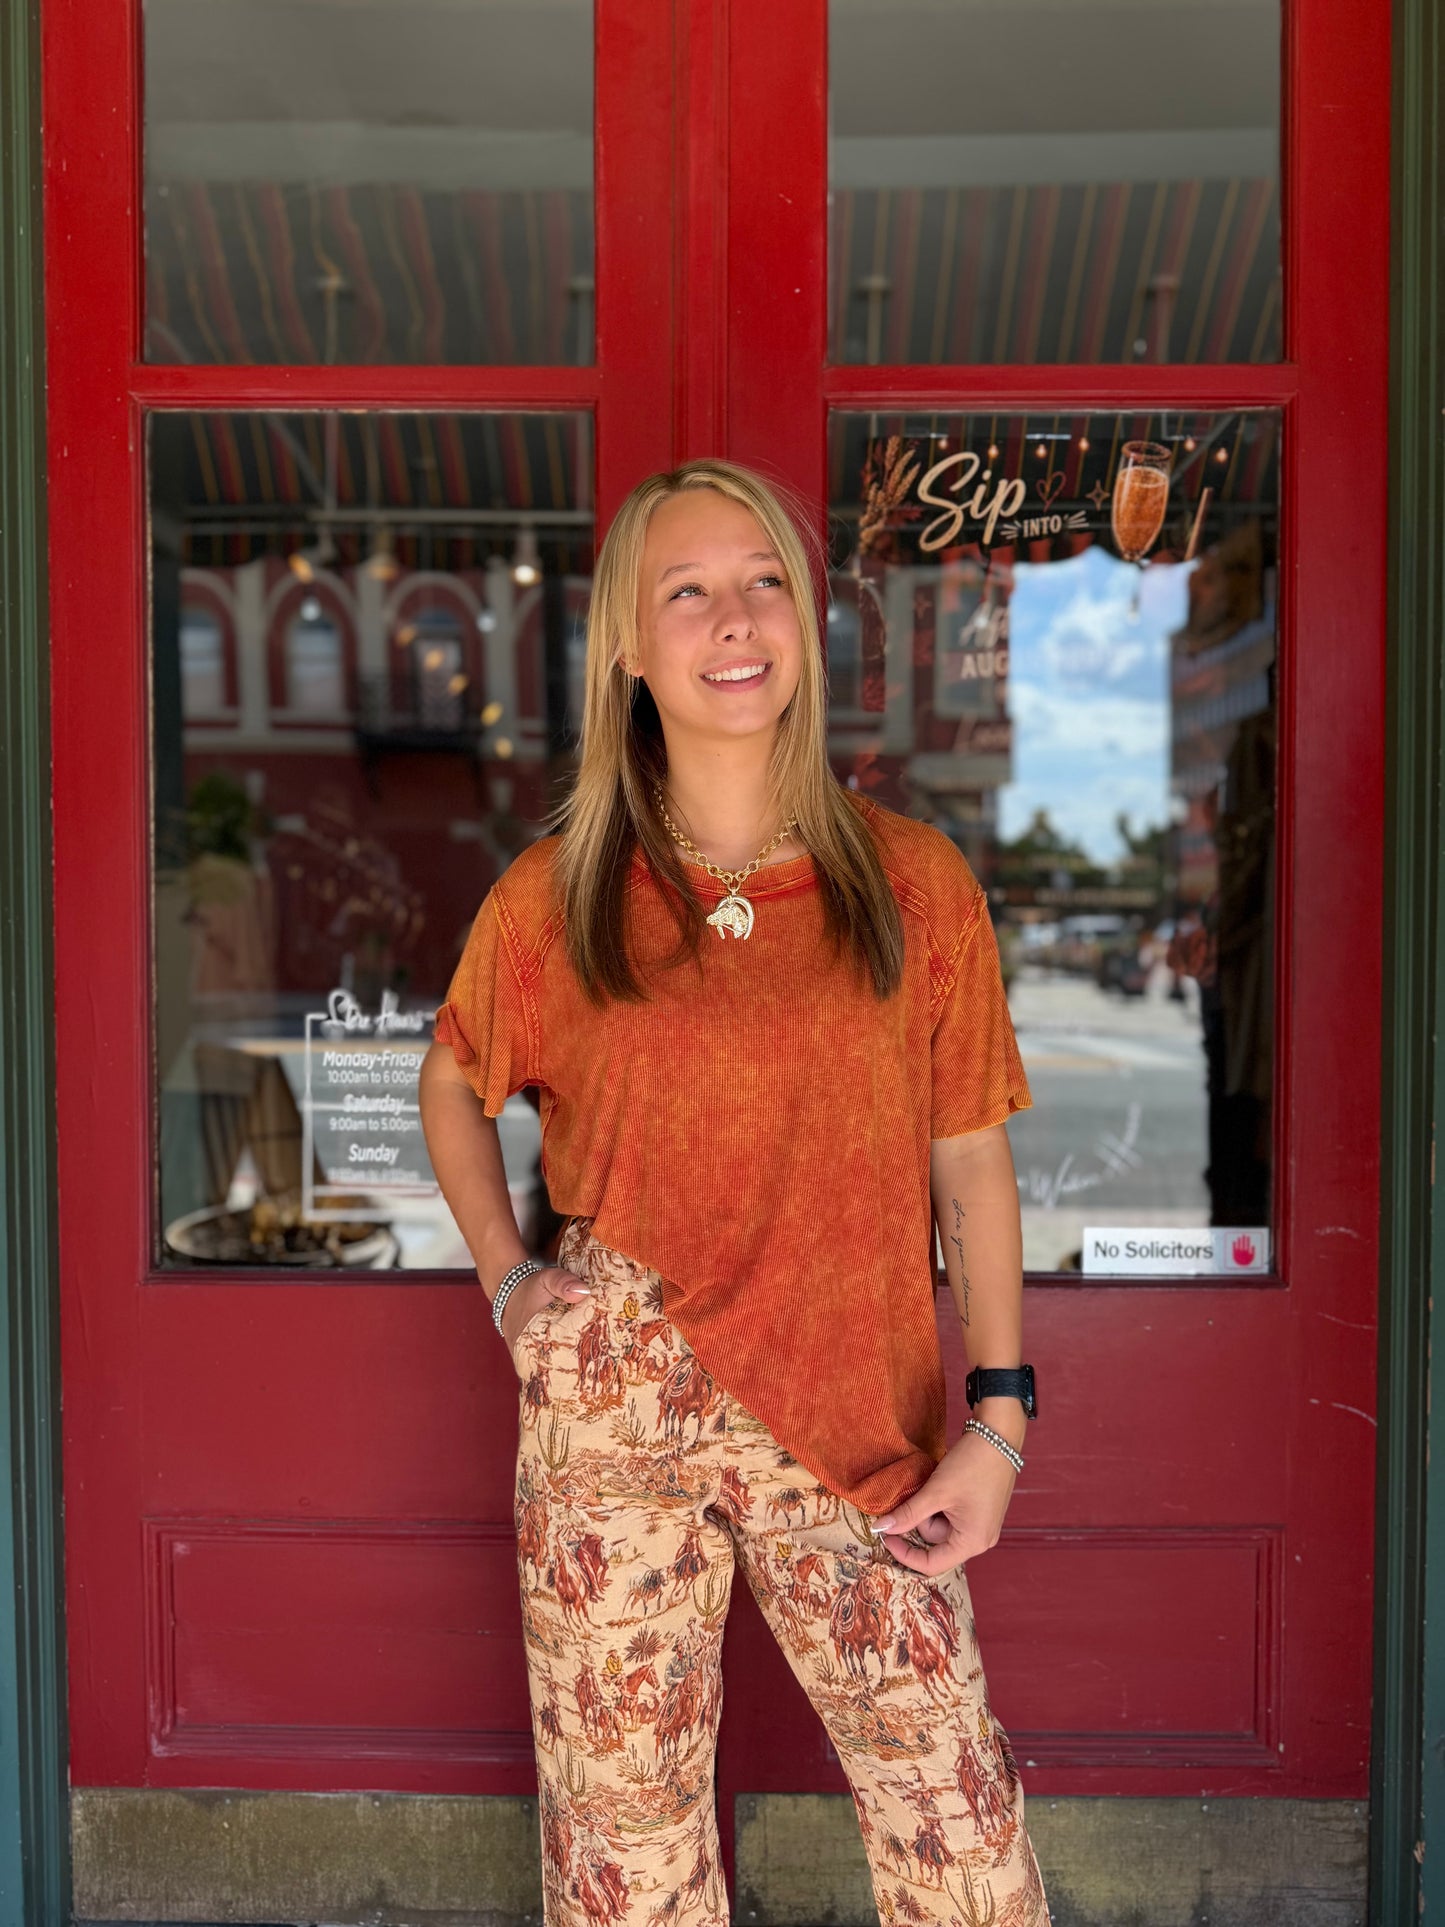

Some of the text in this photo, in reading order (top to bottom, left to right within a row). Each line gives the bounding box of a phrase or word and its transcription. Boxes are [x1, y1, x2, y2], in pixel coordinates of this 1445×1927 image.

[917, 451, 1026, 552] Sip
[1022, 513, 1062, 538] INTO
[322, 1050, 425, 1070] Monday-Friday
[370, 1070, 382, 1083] to
[343, 1093, 406, 1116] Saturday
[368, 1117, 379, 1131] to
[348, 1142, 400, 1166] Sunday
[1094, 1240, 1214, 1260] No Solicitors
